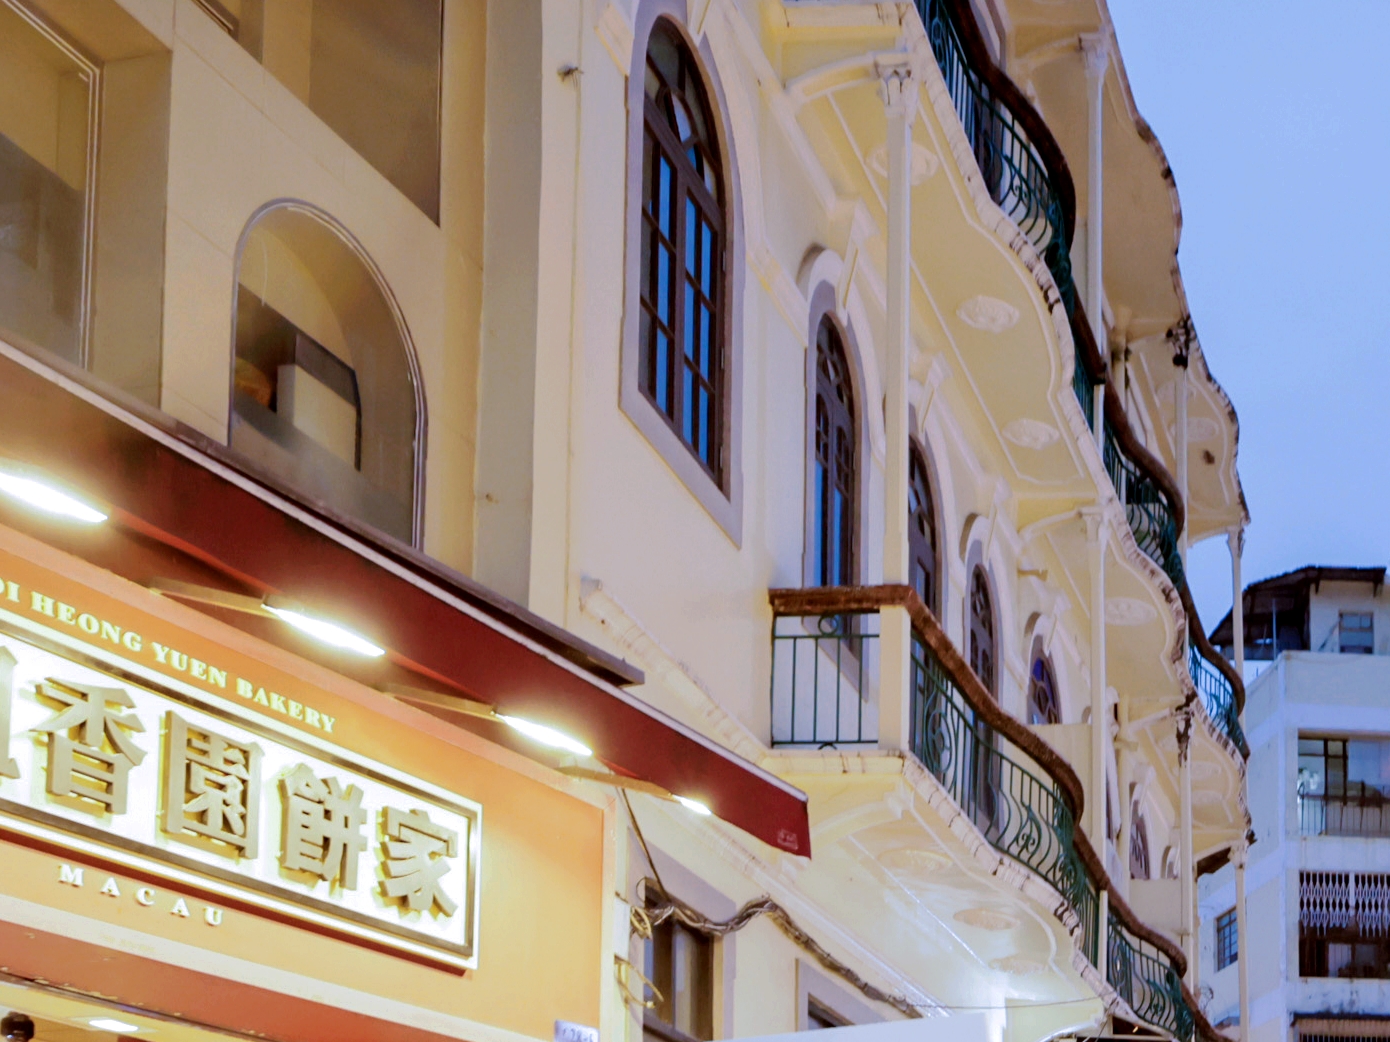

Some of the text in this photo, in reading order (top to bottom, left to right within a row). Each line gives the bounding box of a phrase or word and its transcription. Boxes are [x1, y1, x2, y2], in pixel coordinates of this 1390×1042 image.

[0, 578, 336, 733] I HEONG YUEN BAKERY
[0, 645, 459, 918] 香園餅家
[58, 863, 224, 926] MACAU
